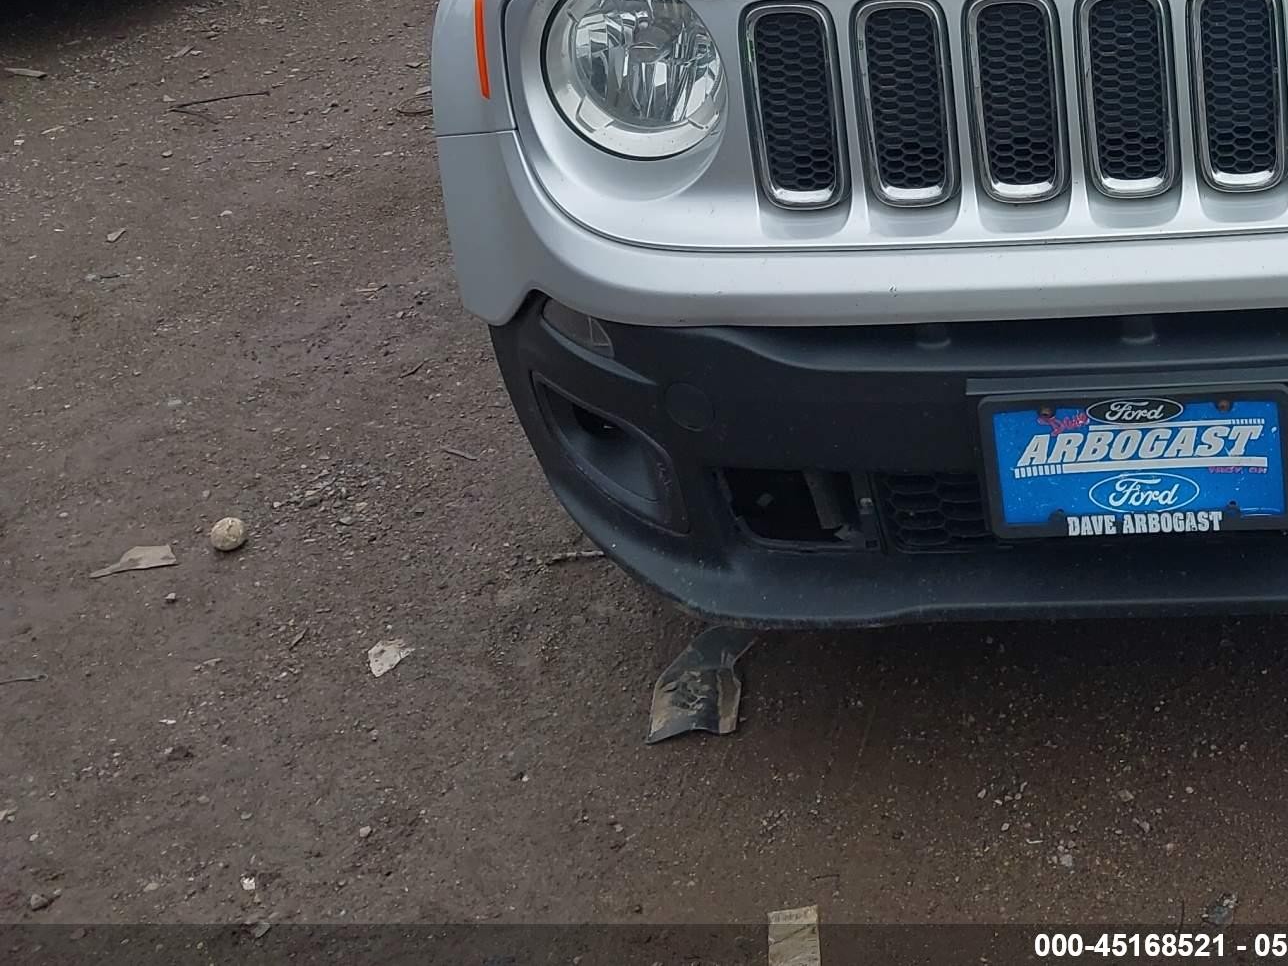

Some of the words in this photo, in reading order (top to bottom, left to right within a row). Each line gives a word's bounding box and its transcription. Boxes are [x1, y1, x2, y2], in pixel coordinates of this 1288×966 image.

[1105, 401, 1165, 422] Ford
[1017, 425, 1265, 467] ARBOGAST
[1108, 479, 1178, 507] Ford
[1067, 516, 1117, 536] DAVE
[1122, 512, 1223, 534] ARBOGAST
